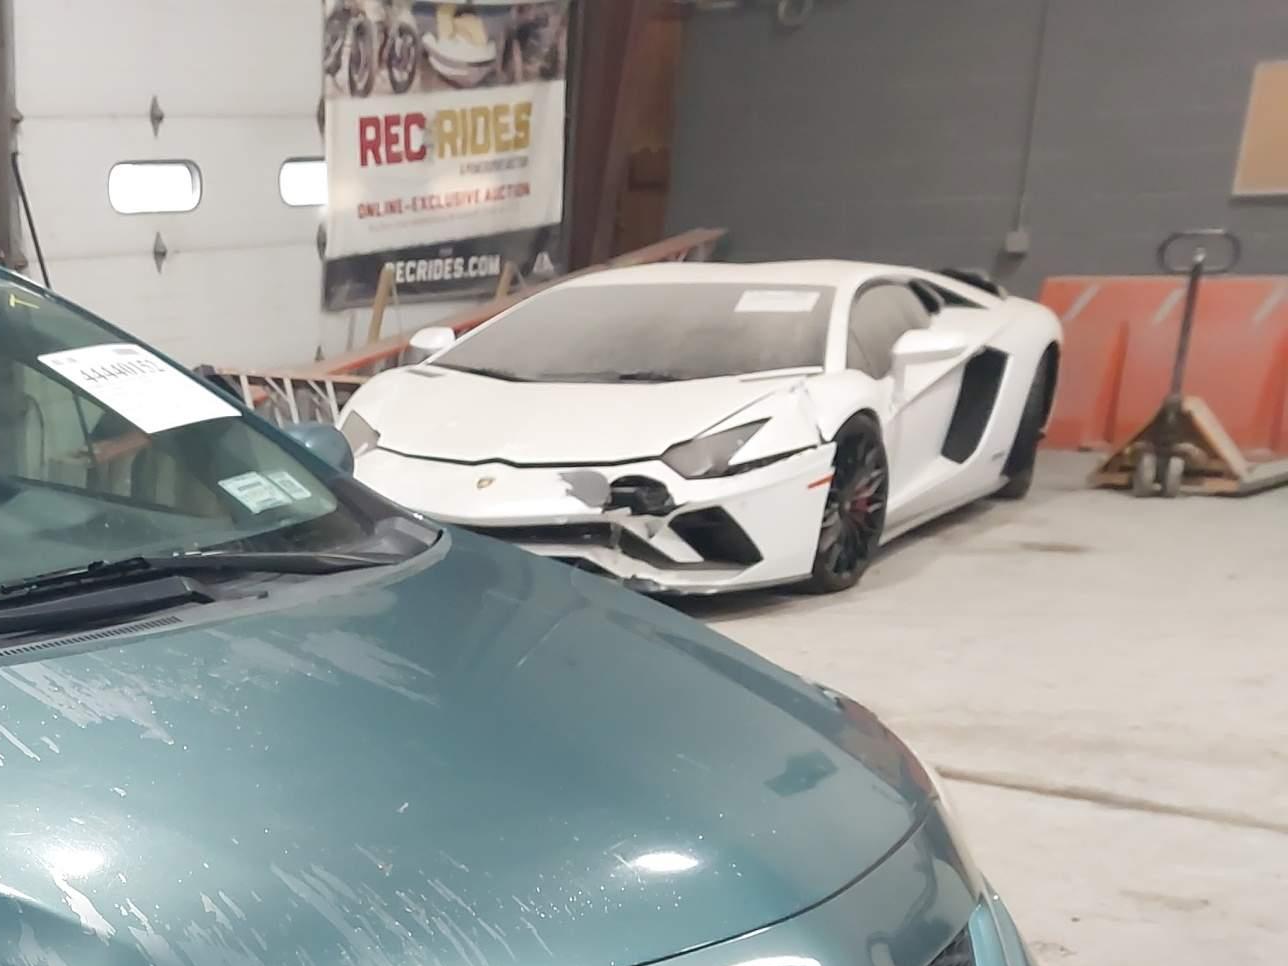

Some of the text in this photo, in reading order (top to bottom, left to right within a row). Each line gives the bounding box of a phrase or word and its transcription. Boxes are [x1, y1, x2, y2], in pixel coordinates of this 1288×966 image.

[359, 102, 533, 167] REC RIDES
[357, 187, 480, 220] ONLINE-EXCLUSIVE
[484, 182, 532, 204] AUCTION
